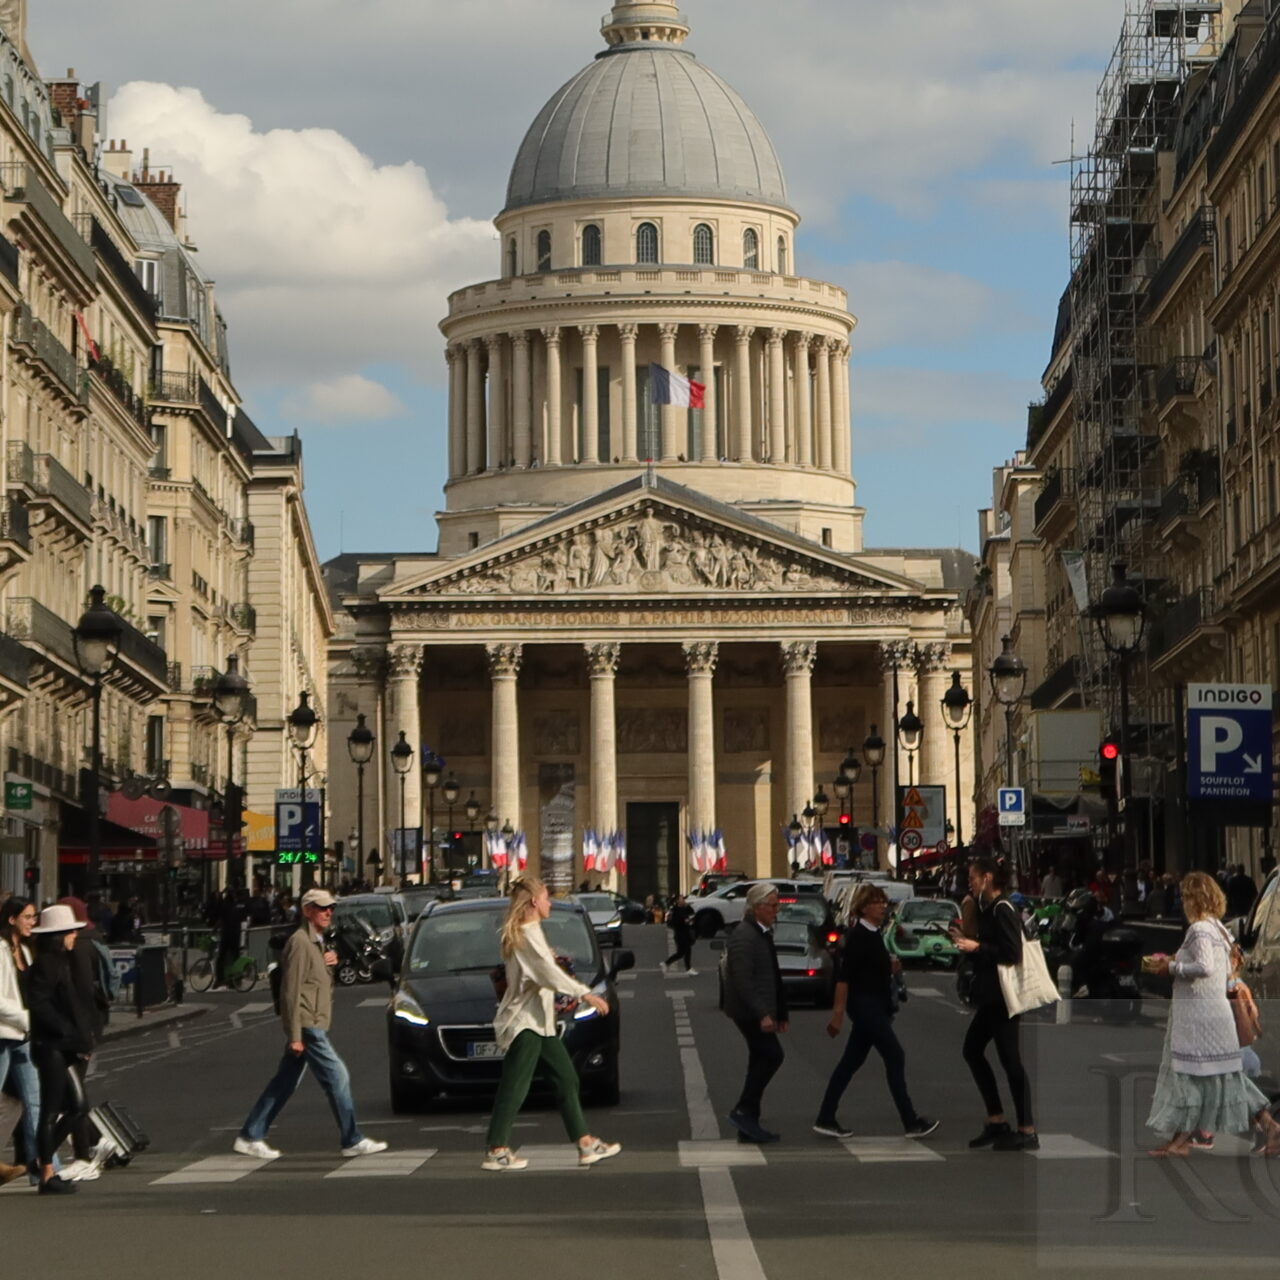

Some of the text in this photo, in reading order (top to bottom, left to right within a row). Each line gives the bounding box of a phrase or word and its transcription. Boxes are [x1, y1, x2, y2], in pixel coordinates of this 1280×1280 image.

[455, 613, 484, 627] AUX
[491, 612, 550, 626] GRANDS
[552, 611, 618, 626] HOMMES
[628, 611, 647, 625] LA
[651, 611, 705, 625] PATRIE
[1199, 689, 1262, 705] INDIGO
[1200, 716, 1243, 772] P
[1200, 776, 1245, 785] SOUFFLOT
[1004, 792, 1017, 810] P
[279, 803, 303, 836] P
[906, 835, 917, 844] 30
